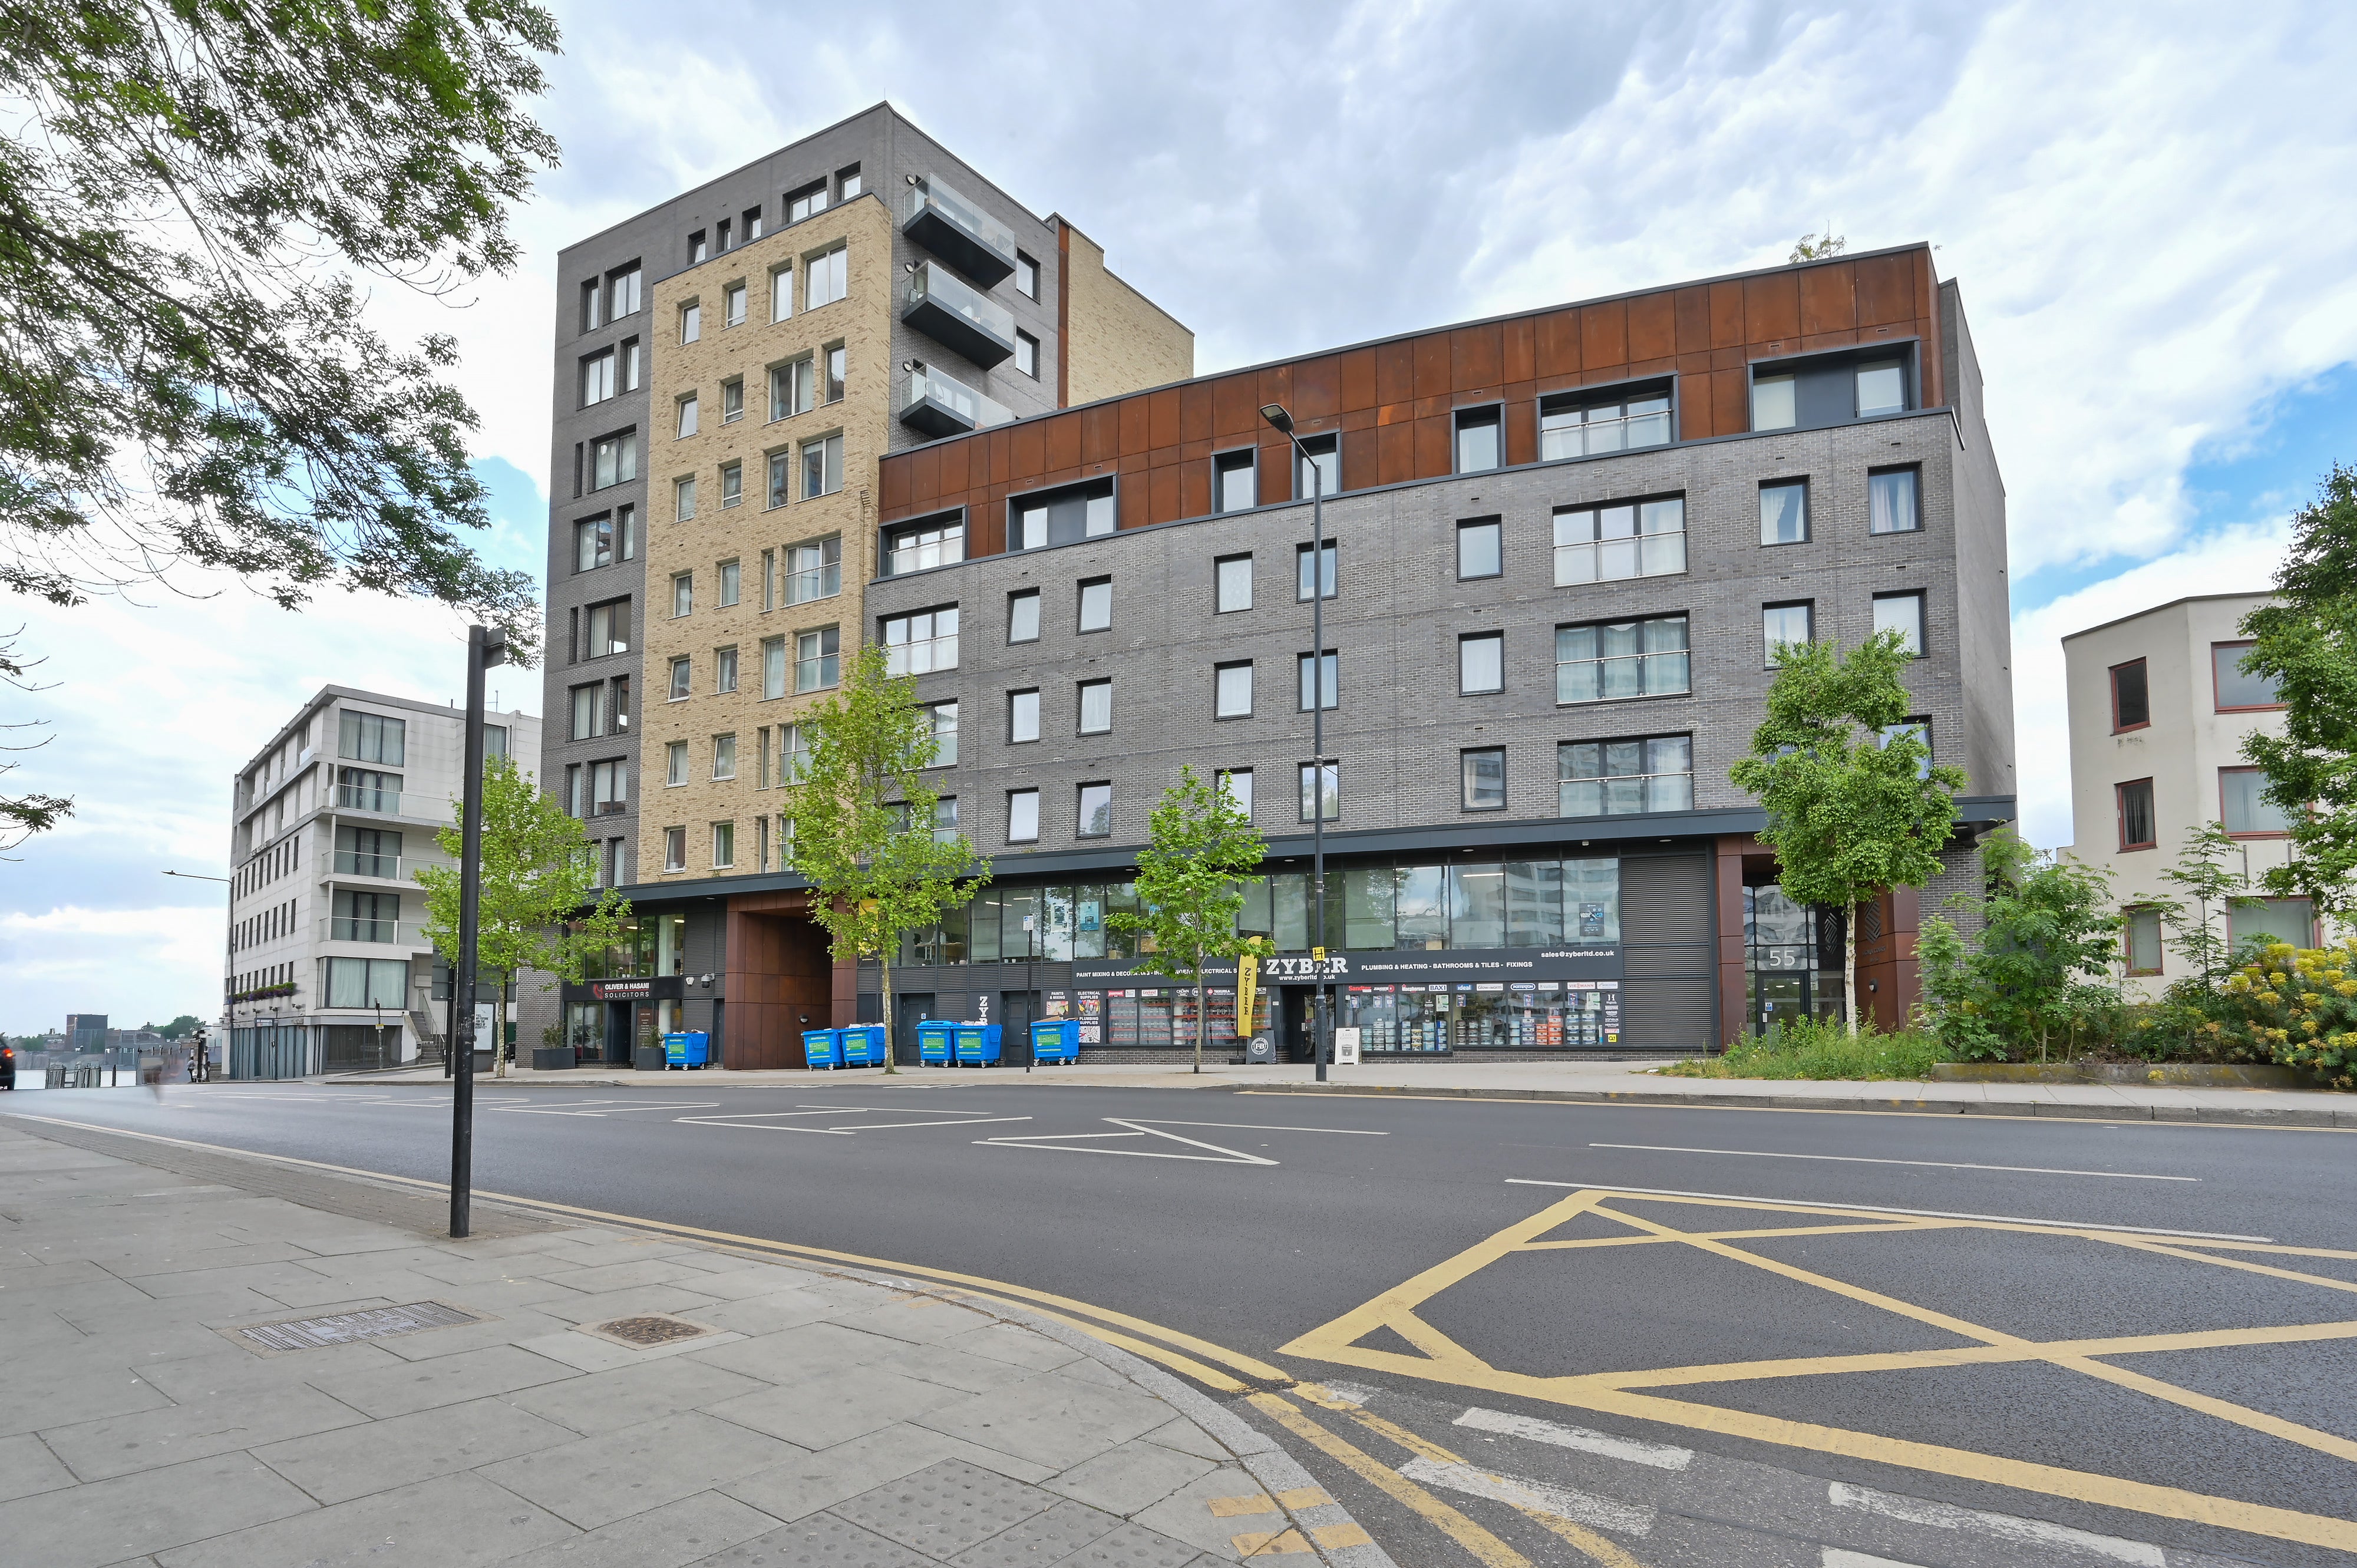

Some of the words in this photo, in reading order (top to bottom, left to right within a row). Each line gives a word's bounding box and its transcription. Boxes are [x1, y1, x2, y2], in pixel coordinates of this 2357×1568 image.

[1314, 949, 1323, 959] H
[1541, 950, 1615, 958] sales@zyberltd.co.uk
[1770, 950, 1795, 967] 55
